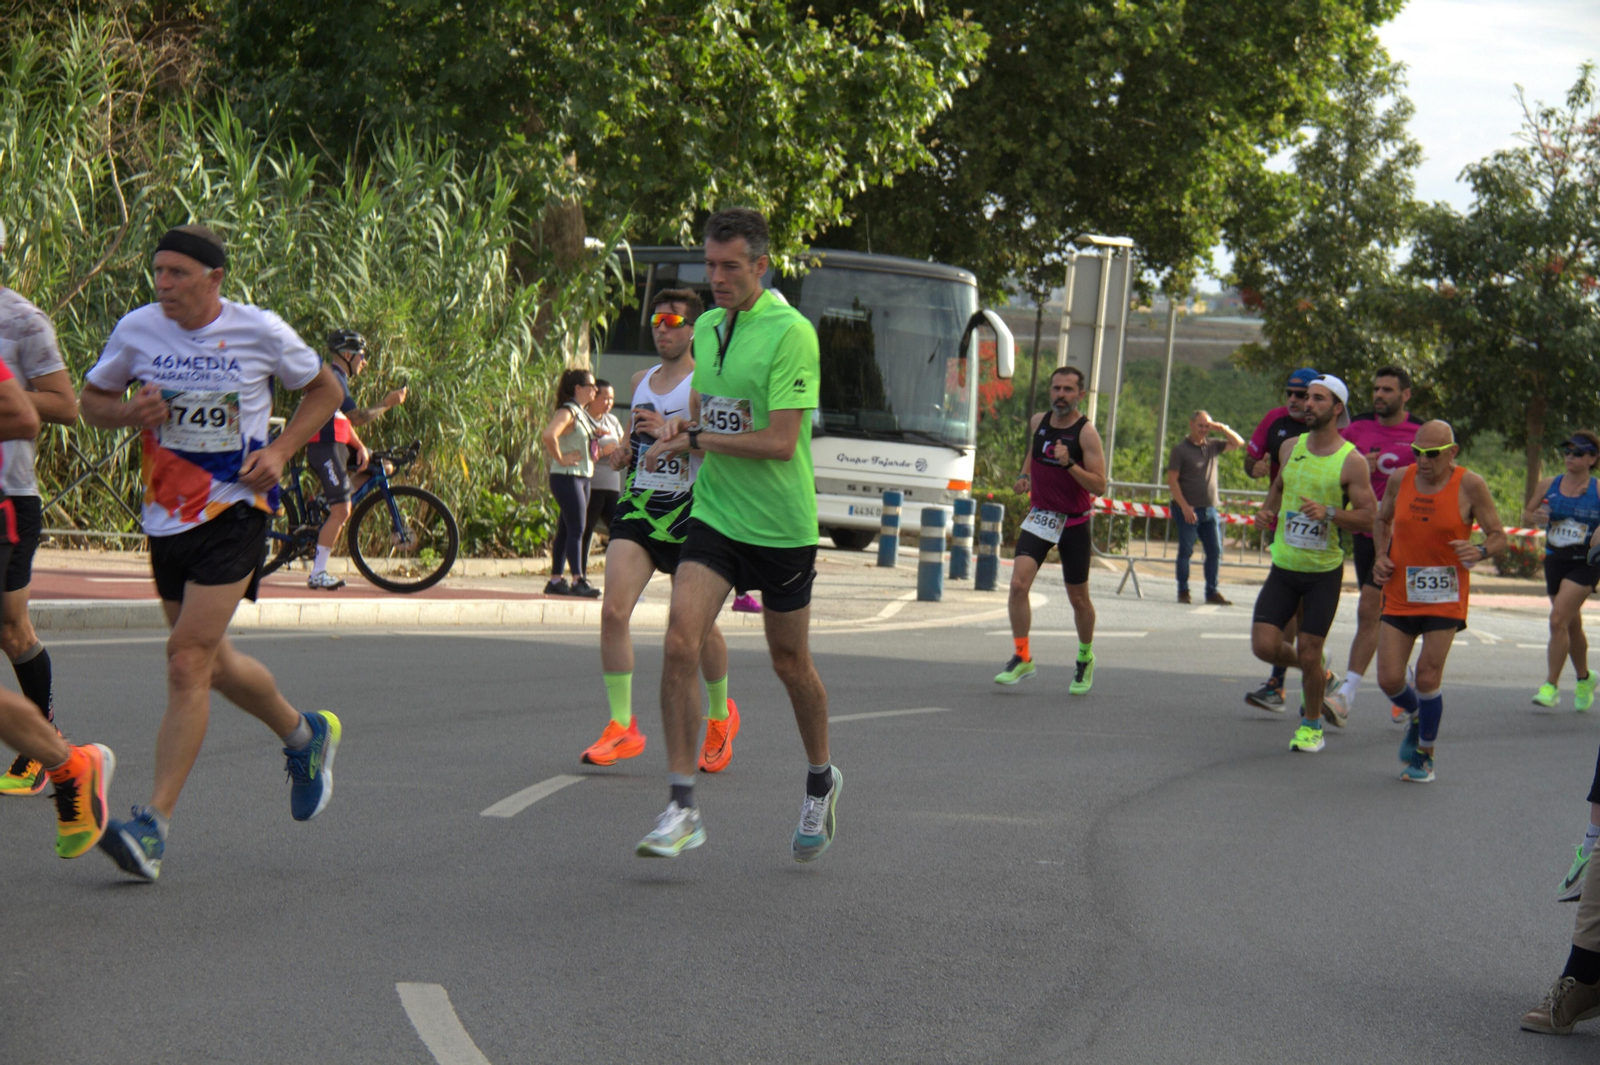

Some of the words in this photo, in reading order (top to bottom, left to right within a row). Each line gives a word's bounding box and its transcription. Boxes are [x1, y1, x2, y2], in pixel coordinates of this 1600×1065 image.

[173, 406, 226, 428] 749
[708, 409, 740, 432] 459
[647, 458, 680, 475] 29
[836, 453, 868, 465] Grupo
[871, 456, 912, 468] Fajardo
[846, 484, 913, 497] SETA
[1034, 515, 1057, 529] 586
[1291, 521, 1320, 537] 774
[1556, 527, 1578, 538] 1115
[1416, 576, 1449, 589] 535
